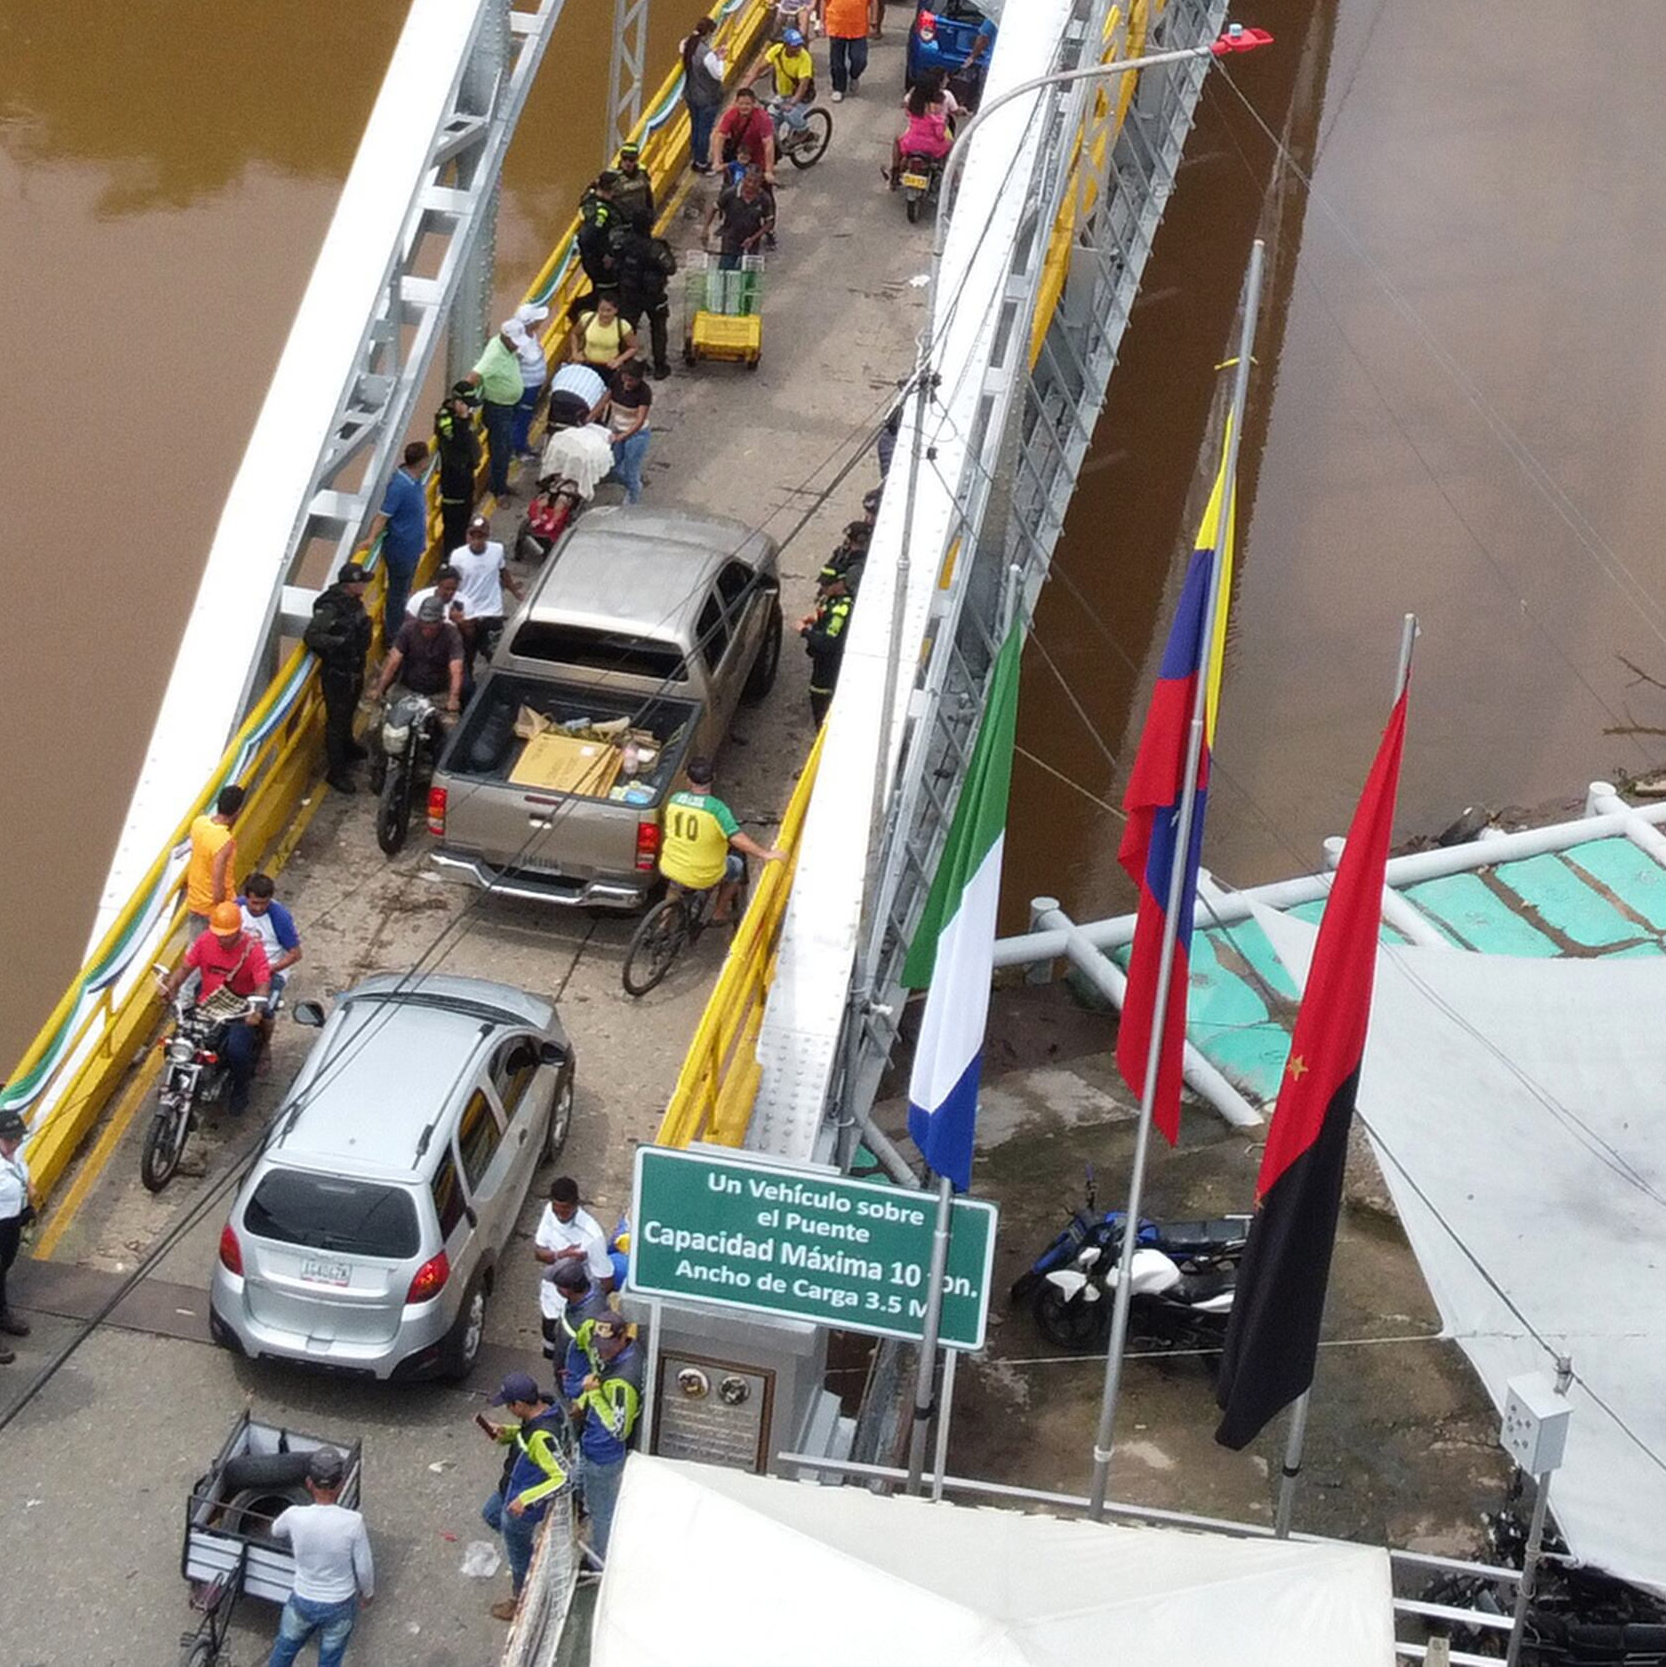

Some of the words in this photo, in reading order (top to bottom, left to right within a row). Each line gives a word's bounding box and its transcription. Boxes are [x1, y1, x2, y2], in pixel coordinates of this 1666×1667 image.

[674, 811, 699, 842] 10
[708, 1172, 742, 1194] Un
[748, 1178, 851, 1213] Vehículo
[857, 1201, 925, 1226] sobre
[757, 1209, 780, 1228] el
[785, 1212, 871, 1243] Puente
[644, 1220, 774, 1262] Capacidad
[780, 1241, 883, 1282] Máxima
[889, 1261, 922, 1288] 10
[927, 1272, 978, 1298] on.
[675, 1259, 751, 1288] Ancho
[756, 1272, 787, 1293] de
[792, 1278, 859, 1308] Carga
[864, 1291, 903, 1314] 3.5
